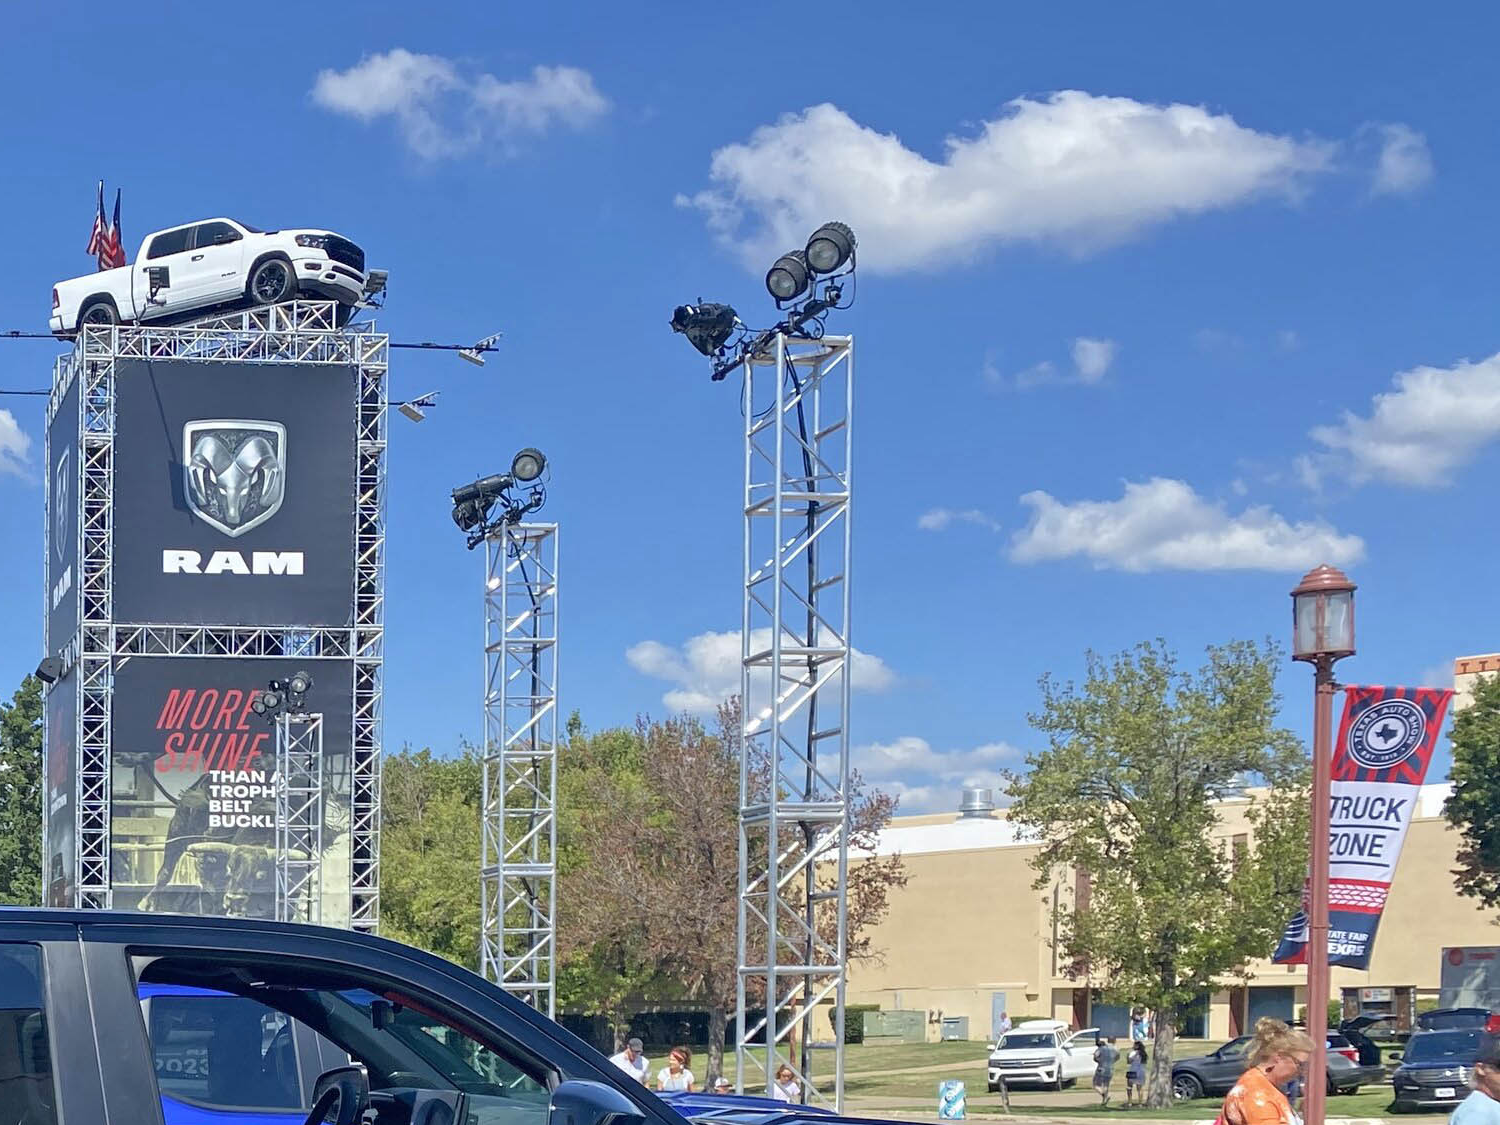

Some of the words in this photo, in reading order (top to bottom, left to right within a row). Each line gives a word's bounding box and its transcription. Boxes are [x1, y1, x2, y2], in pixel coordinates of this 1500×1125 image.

[163, 549, 304, 576] RAM
[156, 688, 262, 731] MORE
[1382, 706, 1410, 716] AUTO
[1406, 715, 1419, 744] SHOW
[155, 732, 270, 773] SHINE
[209, 770, 266, 783] THAN
[209, 800, 252, 813] BELT
[1329, 832, 1387, 858] ZONE
[1328, 930, 1347, 941] TATE
[1348, 931, 1369, 942] FAIR
[1328, 943, 1366, 956] EXAS
